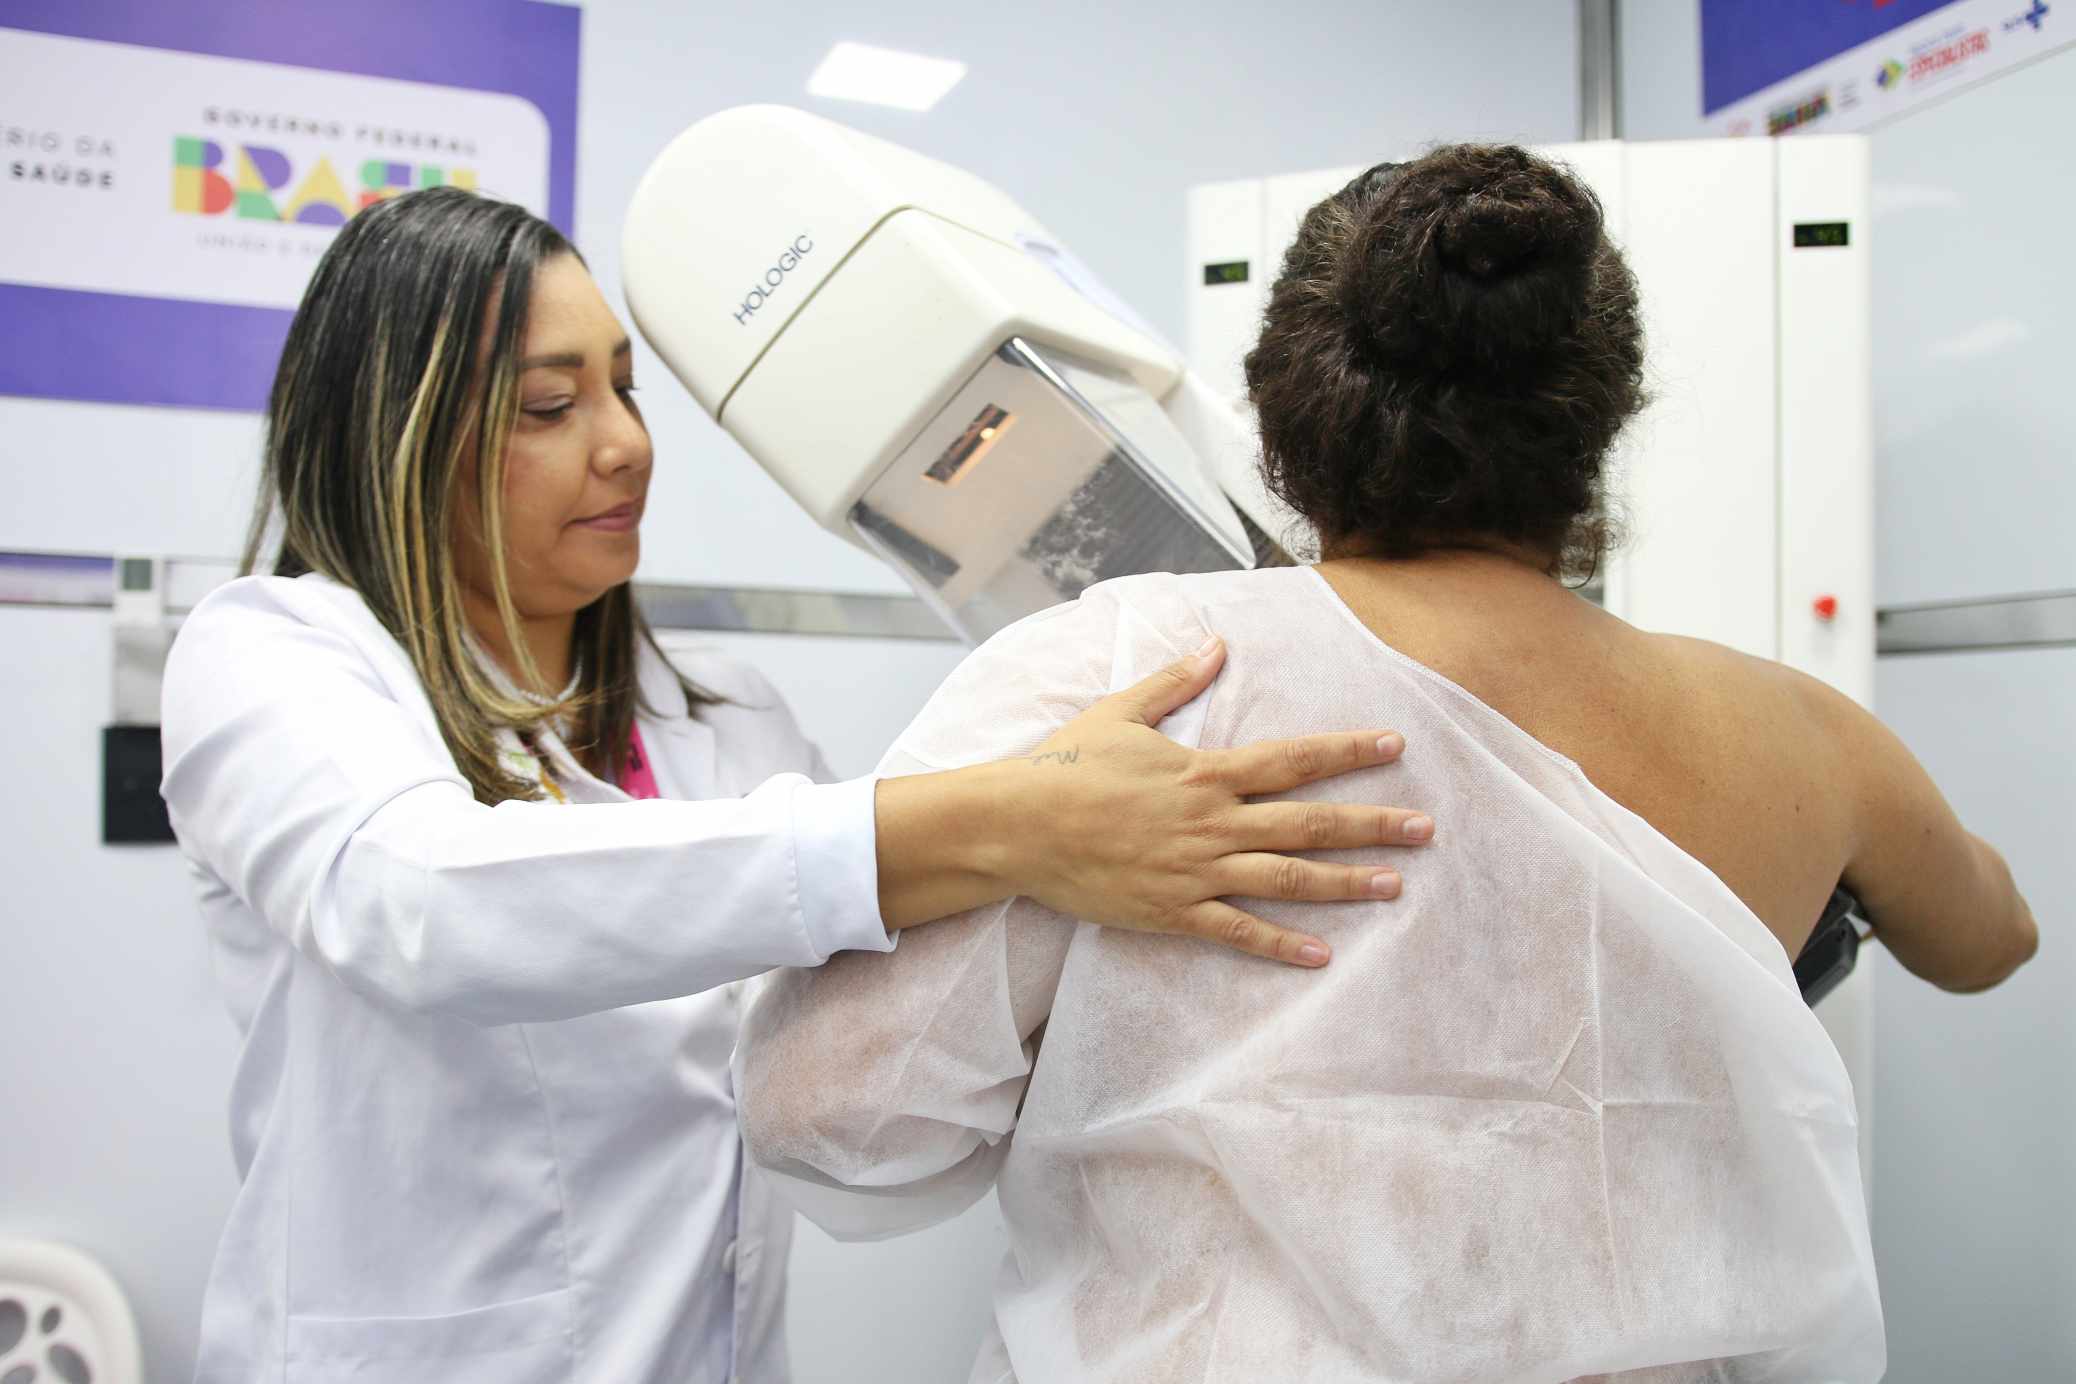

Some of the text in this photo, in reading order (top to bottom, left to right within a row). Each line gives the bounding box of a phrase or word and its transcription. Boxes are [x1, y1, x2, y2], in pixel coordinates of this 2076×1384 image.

[204, 107, 477, 156] GOVERNO FEDERAL
[734, 234, 813, 326] HOLOGIC
